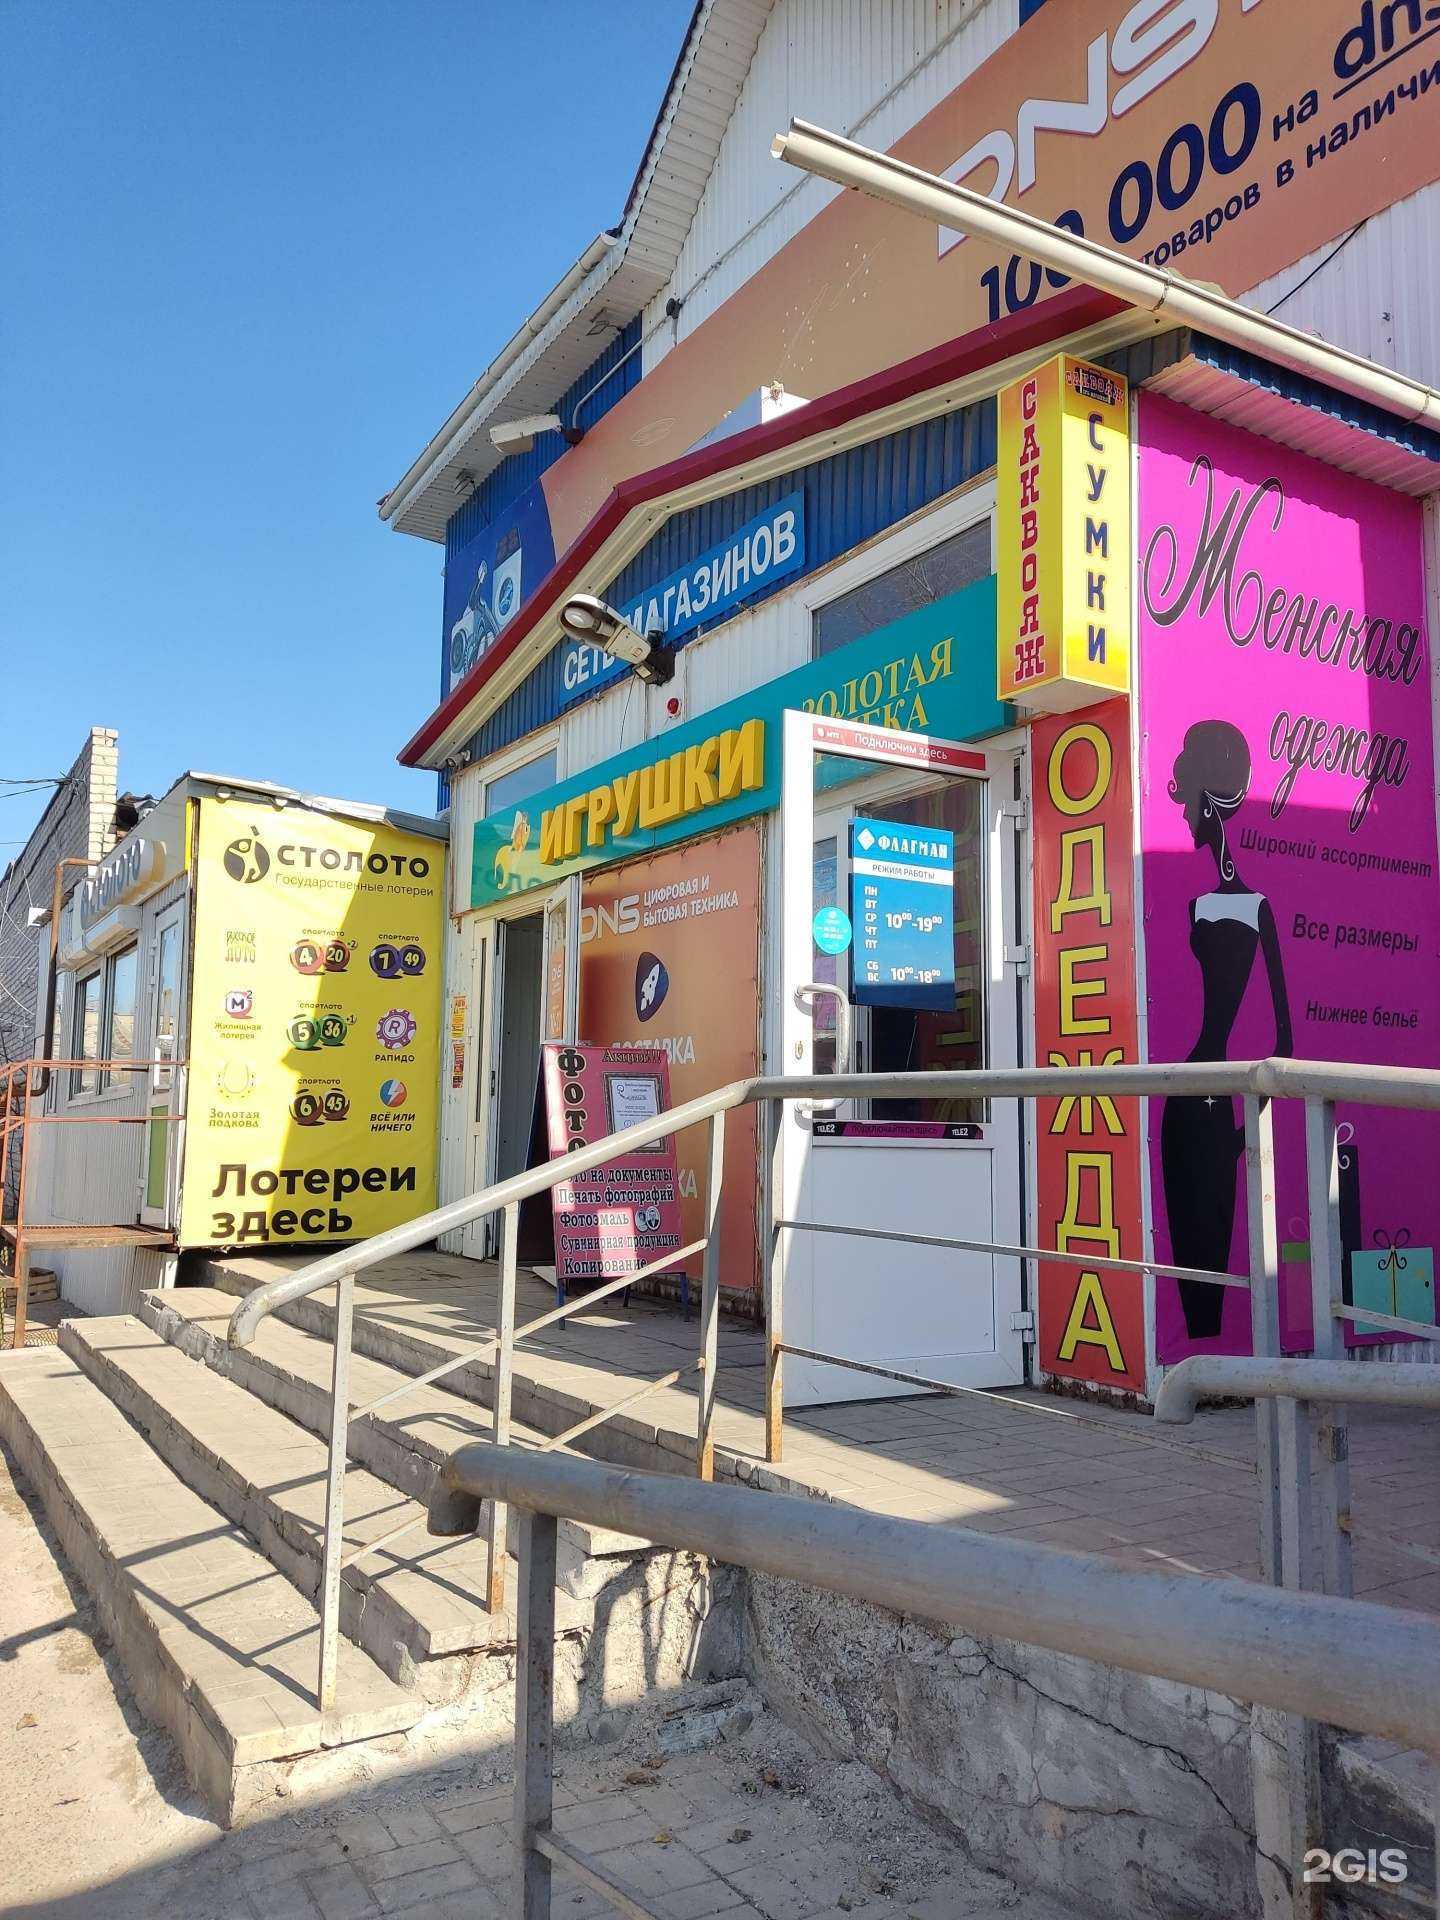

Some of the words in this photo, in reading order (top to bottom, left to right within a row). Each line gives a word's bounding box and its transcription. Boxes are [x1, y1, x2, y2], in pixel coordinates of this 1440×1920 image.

[939, 0, 1217, 260] DNS
[1108, 82, 1261, 244] 000
[1273, 90, 1319, 141] на
[1143, 187, 1260, 266] товаров
[1277, 159, 1295, 188] в
[1307, 60, 1440, 167] наличи
[1014, 379, 1045, 683] САКВОЯЖ
[1085, 411, 1108, 665] СУМКИ
[1143, 454, 1422, 686] Женская
[855, 733, 917, 753] Подключим
[919, 744, 948, 760] здесь
[1269, 710, 1410, 834] одежда
[539, 718, 765, 865] ИГРУШКИ
[878, 835, 948, 859] ФЛАГМАН
[1239, 828, 1317, 860] Широкий
[1321, 846, 1433, 878] ассортимент
[277, 845, 430, 878] СТОЛОТО
[872, 864, 902, 876] РЕЖИМ
[903, 867, 935, 880] РАБОТЫ
[275, 873, 384, 891] Государственные
[387, 883, 434, 897] лотереи
[643, 878, 699, 908] ЦИФРОВАЯ
[702, 874, 710, 891] И
[864, 886, 877, 896] ПН
[643, 902, 688, 927] БЫТОВАЯ
[691, 890, 739, 916] ТЕХНИКА
[865, 912, 877, 922] СР
[580, 894, 640, 944] DNS
[302, 929, 345, 937] СПОРТЛОТО
[378, 934, 420, 942] СПОРТЛОТО
[865, 926, 877, 937] ЧТ
[1292, 913, 1330, 941] Все
[1335, 924, 1420, 954] размеры
[865, 939, 877, 949] ПТ
[327, 947, 344, 963] 20
[404, 952, 420, 966] 49
[866, 960, 879, 970] СБ
[867, 972, 879, 982] ВС
[1306, 1000, 1368, 1024] Нижнее
[1373, 1006, 1419, 1028] бельё
[324, 1020, 341, 1037] 36
[375, 1054, 415, 1063] РАПИДО
[1048, 723, 1128, 1374] ОДЕЖДА
[300, 1097, 312, 1115] 6
[327, 1095, 343, 1111] 45
[209, 1119, 259, 1129] подкова
[370, 1112, 391, 1122] ВСЁ
[393, 1113, 415, 1122] ИЛИ
[371, 1123, 412, 1132] НИЧЕГО
[817, 1124, 836, 1134] TELE2
[952, 1127, 969, 1136] TELE2
[212, 1163, 417, 1202] Лотереи
[591, 1169, 605, 1183] на
[608, 1168, 673, 1186] документы
[560, 1189, 601, 1203] Печать
[605, 1185, 674, 1206] фотографий
[210, 1208, 354, 1242] здесь
[560, 1212, 630, 1227] Фотоэмаль
[627, 1234, 680, 1251] продукция
[565, 1258, 647, 1277] Копирование
